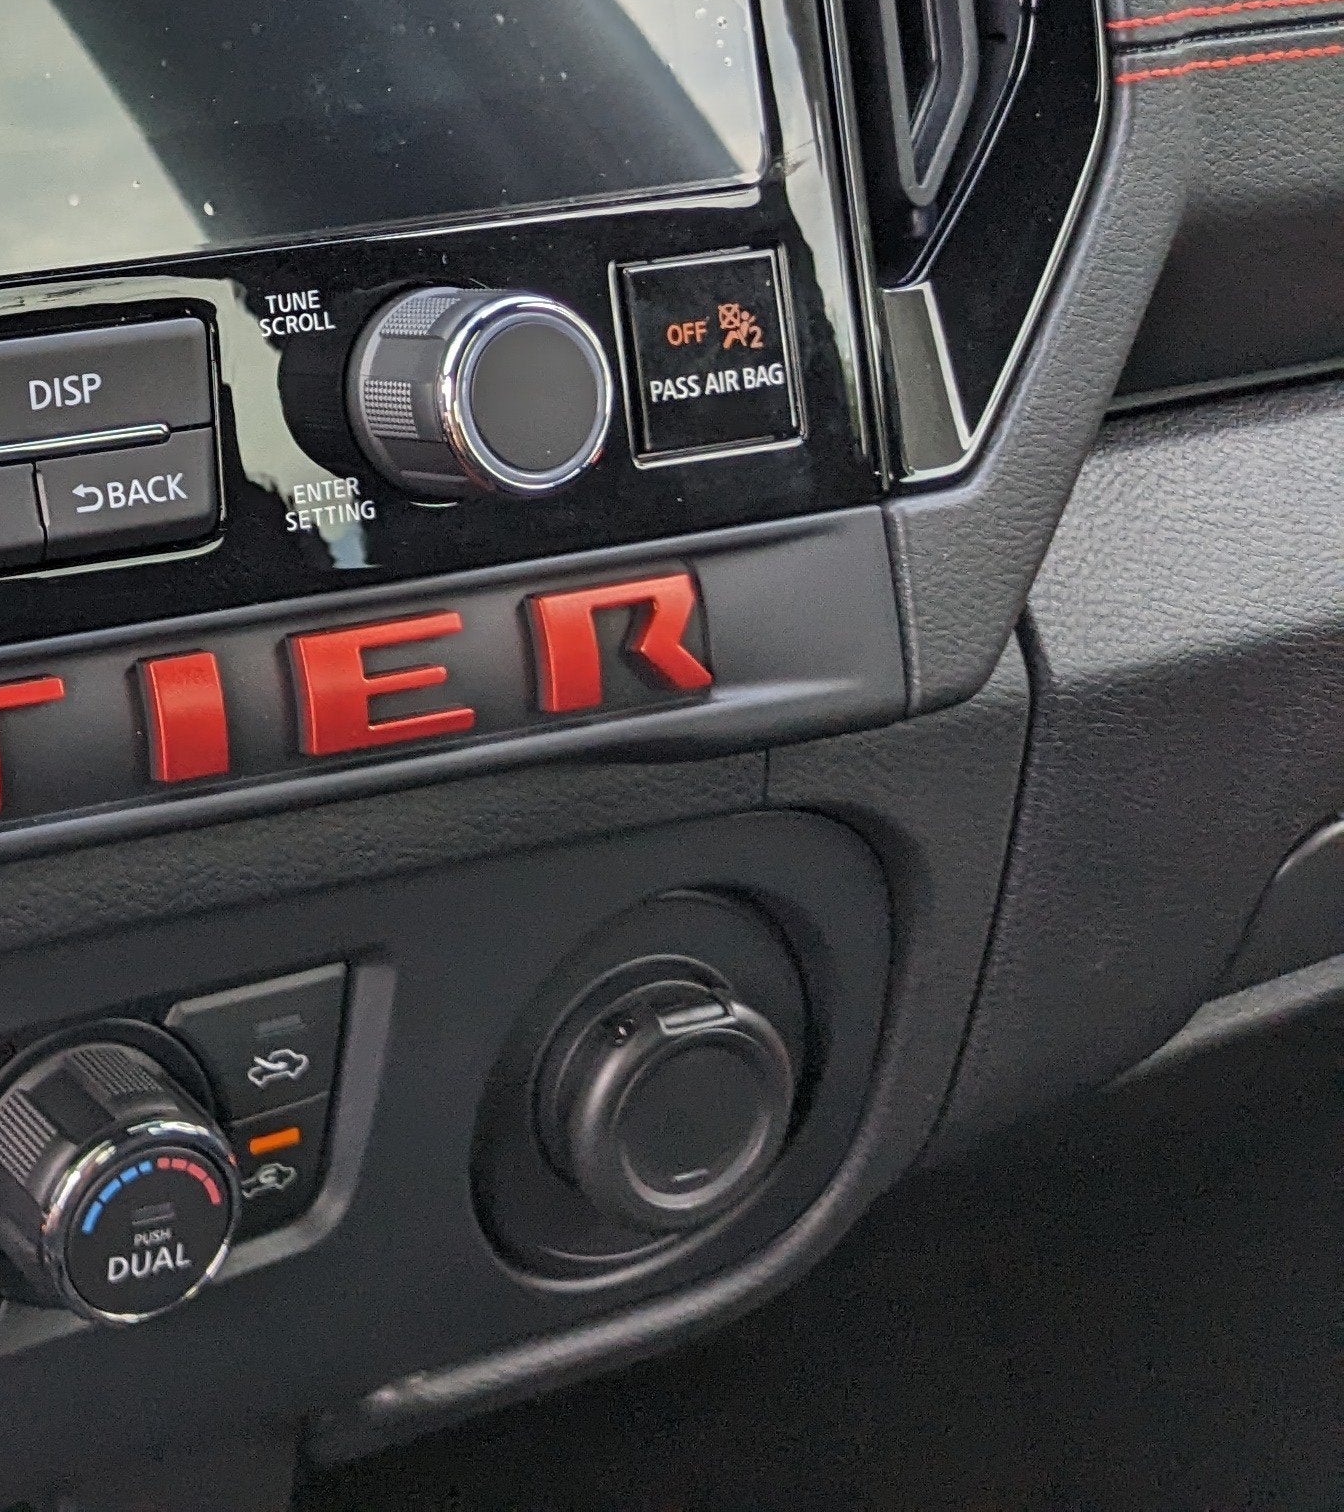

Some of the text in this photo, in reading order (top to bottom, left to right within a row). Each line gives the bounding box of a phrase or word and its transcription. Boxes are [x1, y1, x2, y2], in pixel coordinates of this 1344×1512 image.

[264, 290, 320, 314] TUNE
[259, 311, 336, 337] SCROLL
[666, 320, 708, 346] OFF
[28, 373, 102, 411] DISP
[649, 362, 785, 403] PASS AIR BAG
[106, 472, 188, 512] BACK
[293, 477, 361, 505] ENTER
[285, 500, 376, 532] SETTING
[134, 1228, 172, 1245] PUSH
[106, 1242, 192, 1284] DUAL
